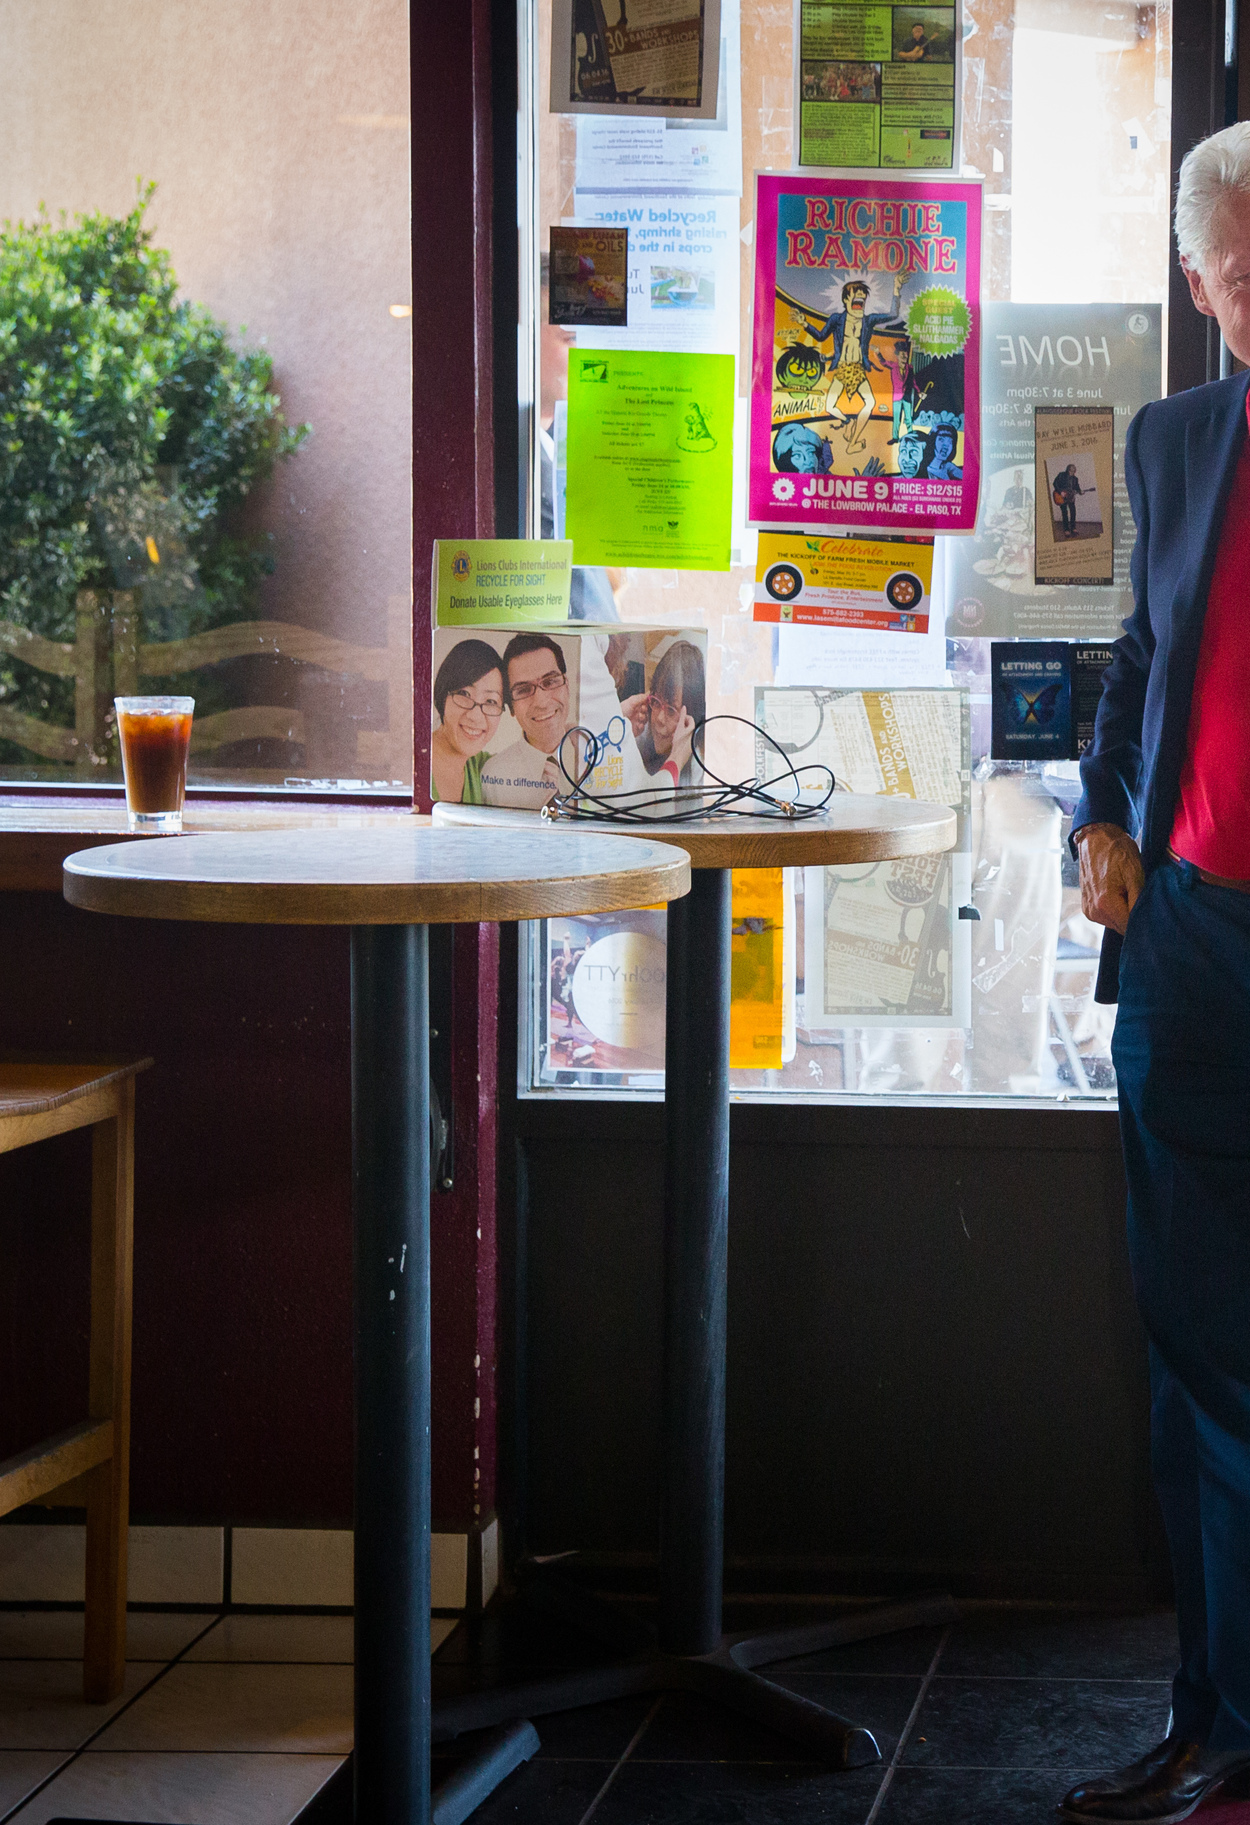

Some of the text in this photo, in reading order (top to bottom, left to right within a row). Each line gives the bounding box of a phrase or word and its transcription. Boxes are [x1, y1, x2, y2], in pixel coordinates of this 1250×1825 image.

[630, 28, 659, 42] BANDS
[641, 30, 699, 50] WORKSHOPS
[805, 197, 942, 238] RICHIE
[785, 230, 957, 275] RAMONE
[925, 306, 953, 314] GUEST
[924, 315, 954, 325] ACID PIE
[913, 324, 964, 335] SLUTHAMMER
[773, 398, 816, 417] ANIMAL
[1053, 426, 1074, 436] WYLIE
[1078, 421, 1111, 432] HUBBARD
[1051, 442, 1067, 451] JUNE
[803, 478, 889, 500] JUNE 9
[893, 483, 962, 496] PRICE: $12/$15
[802, 499, 811, 508] @
[813, 500, 829, 510] THE
[831, 500, 874, 512] LOWBROW
[876, 502, 907, 513] PALACE
[915, 504, 925, 514] EL
[927, 505, 950, 516] PASO,
[951, 505, 961, 515] TX
[821, 540, 883, 556] Celebrate
[477, 559, 567, 571] Lions Clubs International
[867, 558, 888, 566] MOBILE
[476, 574, 546, 587] RECYCLE FOR SIGHT
[450, 594, 562, 609] Donate Usable Eyeglasses Here
[1077, 651, 1113, 660] LETTIN
[1001, 662, 1042, 670] LETTING
[879, 693, 908, 771] WORKSHOPS
[608, 755, 623, 765] Lions
[879, 730, 899, 786] BANDS AND
[594, 765, 623, 777] RECYCLE
[481, 775, 557, 789] Make a difference.
[596, 776, 623, 790] For Sight
